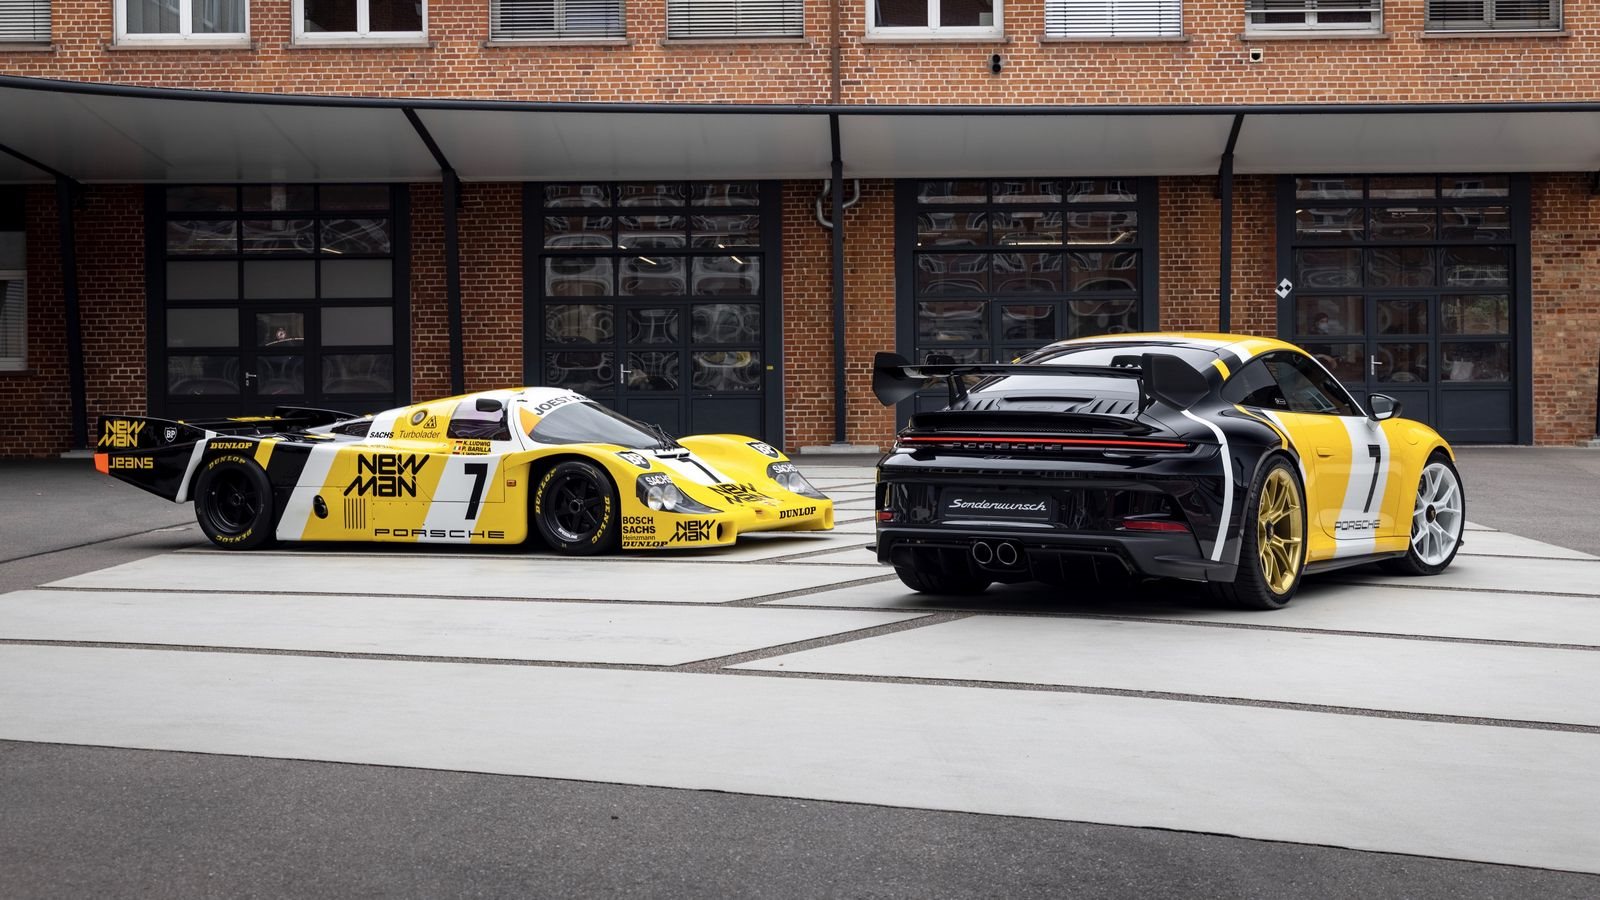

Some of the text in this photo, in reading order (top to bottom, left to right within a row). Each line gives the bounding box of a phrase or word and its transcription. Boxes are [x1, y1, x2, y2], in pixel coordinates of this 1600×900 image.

[399, 430, 440, 438] Turbolader
[952, 442, 1063, 450] PORSCHE
[208, 456, 246, 470] DUNLOP
[773, 464, 798, 473] SACHS
[644, 474, 672, 486] SACHS
[1363, 444, 1382, 514] 7
[464, 463, 488, 520] 7
[536, 468, 556, 514] DUNLOP
[949, 498, 1046, 510] Sonderwunsch
[779, 506, 816, 520] DUNLOP
[622, 516, 654, 524] BOSCH
[1334, 519, 1381, 531] PORSCHE
[374, 528, 504, 538] PORSCHE
[622, 526, 656, 534] SACHS
